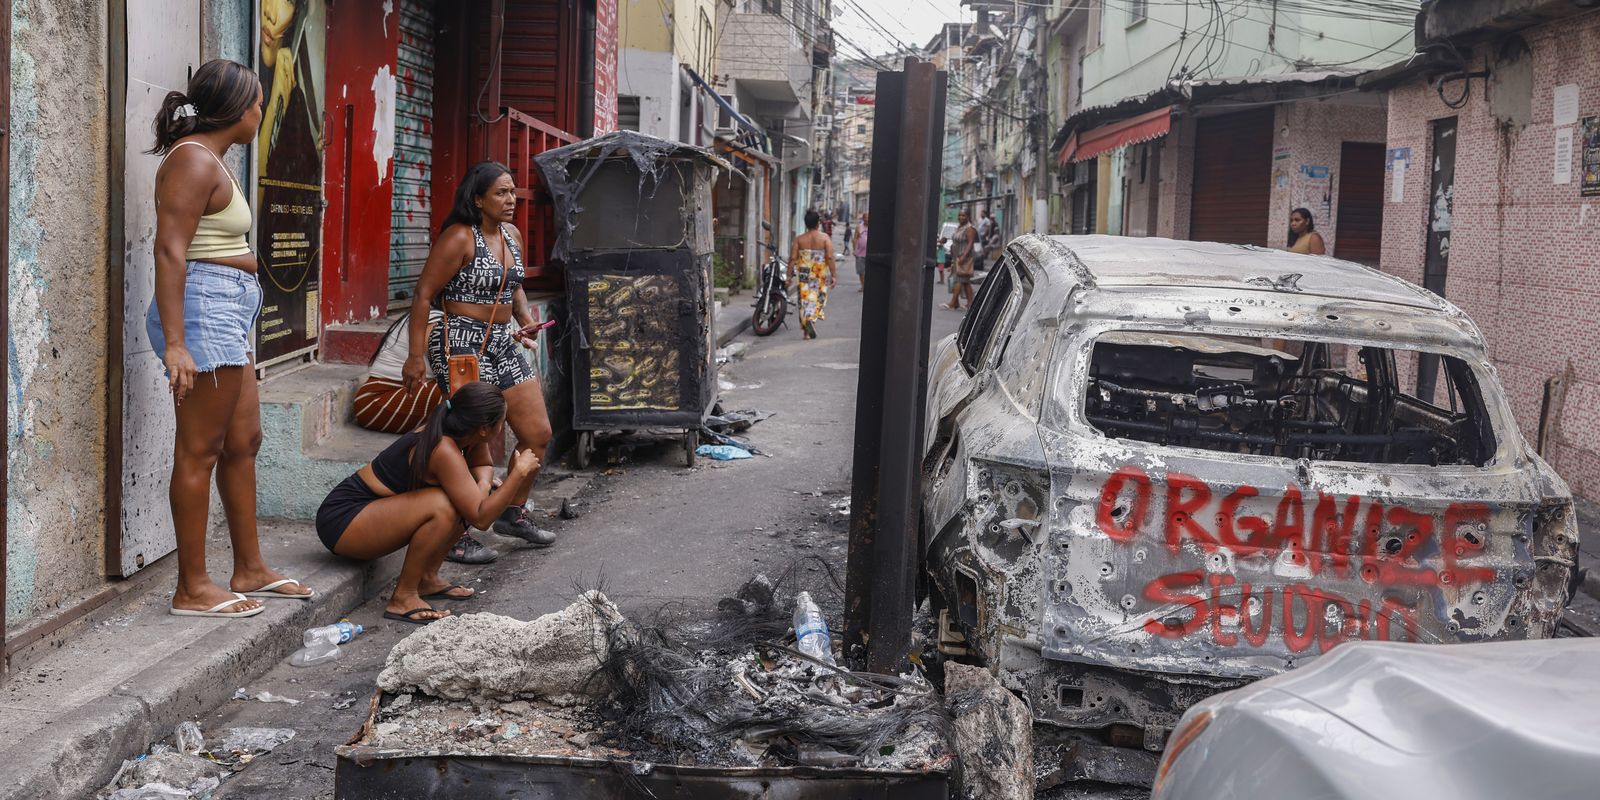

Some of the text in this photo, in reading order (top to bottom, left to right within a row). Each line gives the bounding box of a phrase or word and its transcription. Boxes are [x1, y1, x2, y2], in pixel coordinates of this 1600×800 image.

[472, 268, 494, 277] LIVES
[455, 329, 485, 343] LIVES
[449, 340, 470, 348] LIVES
[1097, 464, 1498, 586] ORGANIZE
